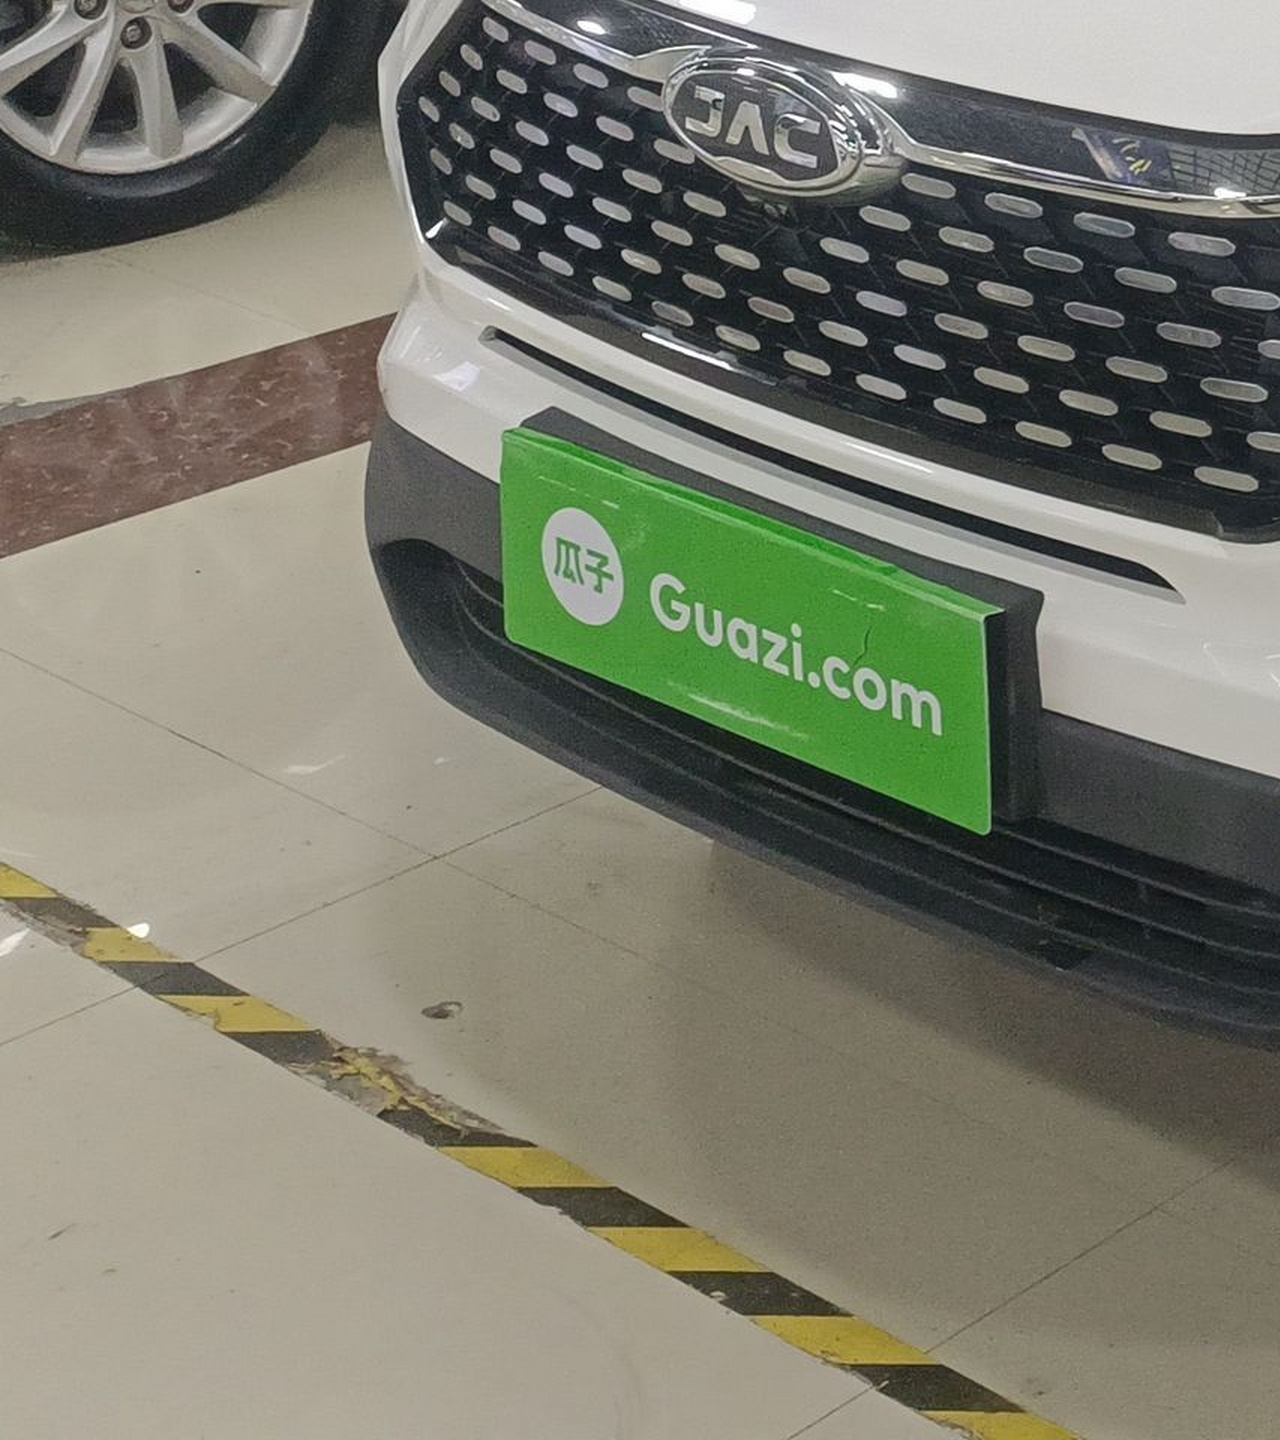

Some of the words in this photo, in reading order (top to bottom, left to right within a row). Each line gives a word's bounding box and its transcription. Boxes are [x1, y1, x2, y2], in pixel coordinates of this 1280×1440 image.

[685, 85, 821, 169] JAC
[554, 537, 614, 594] 瓜子
[650, 573, 943, 736] Guazi.com
